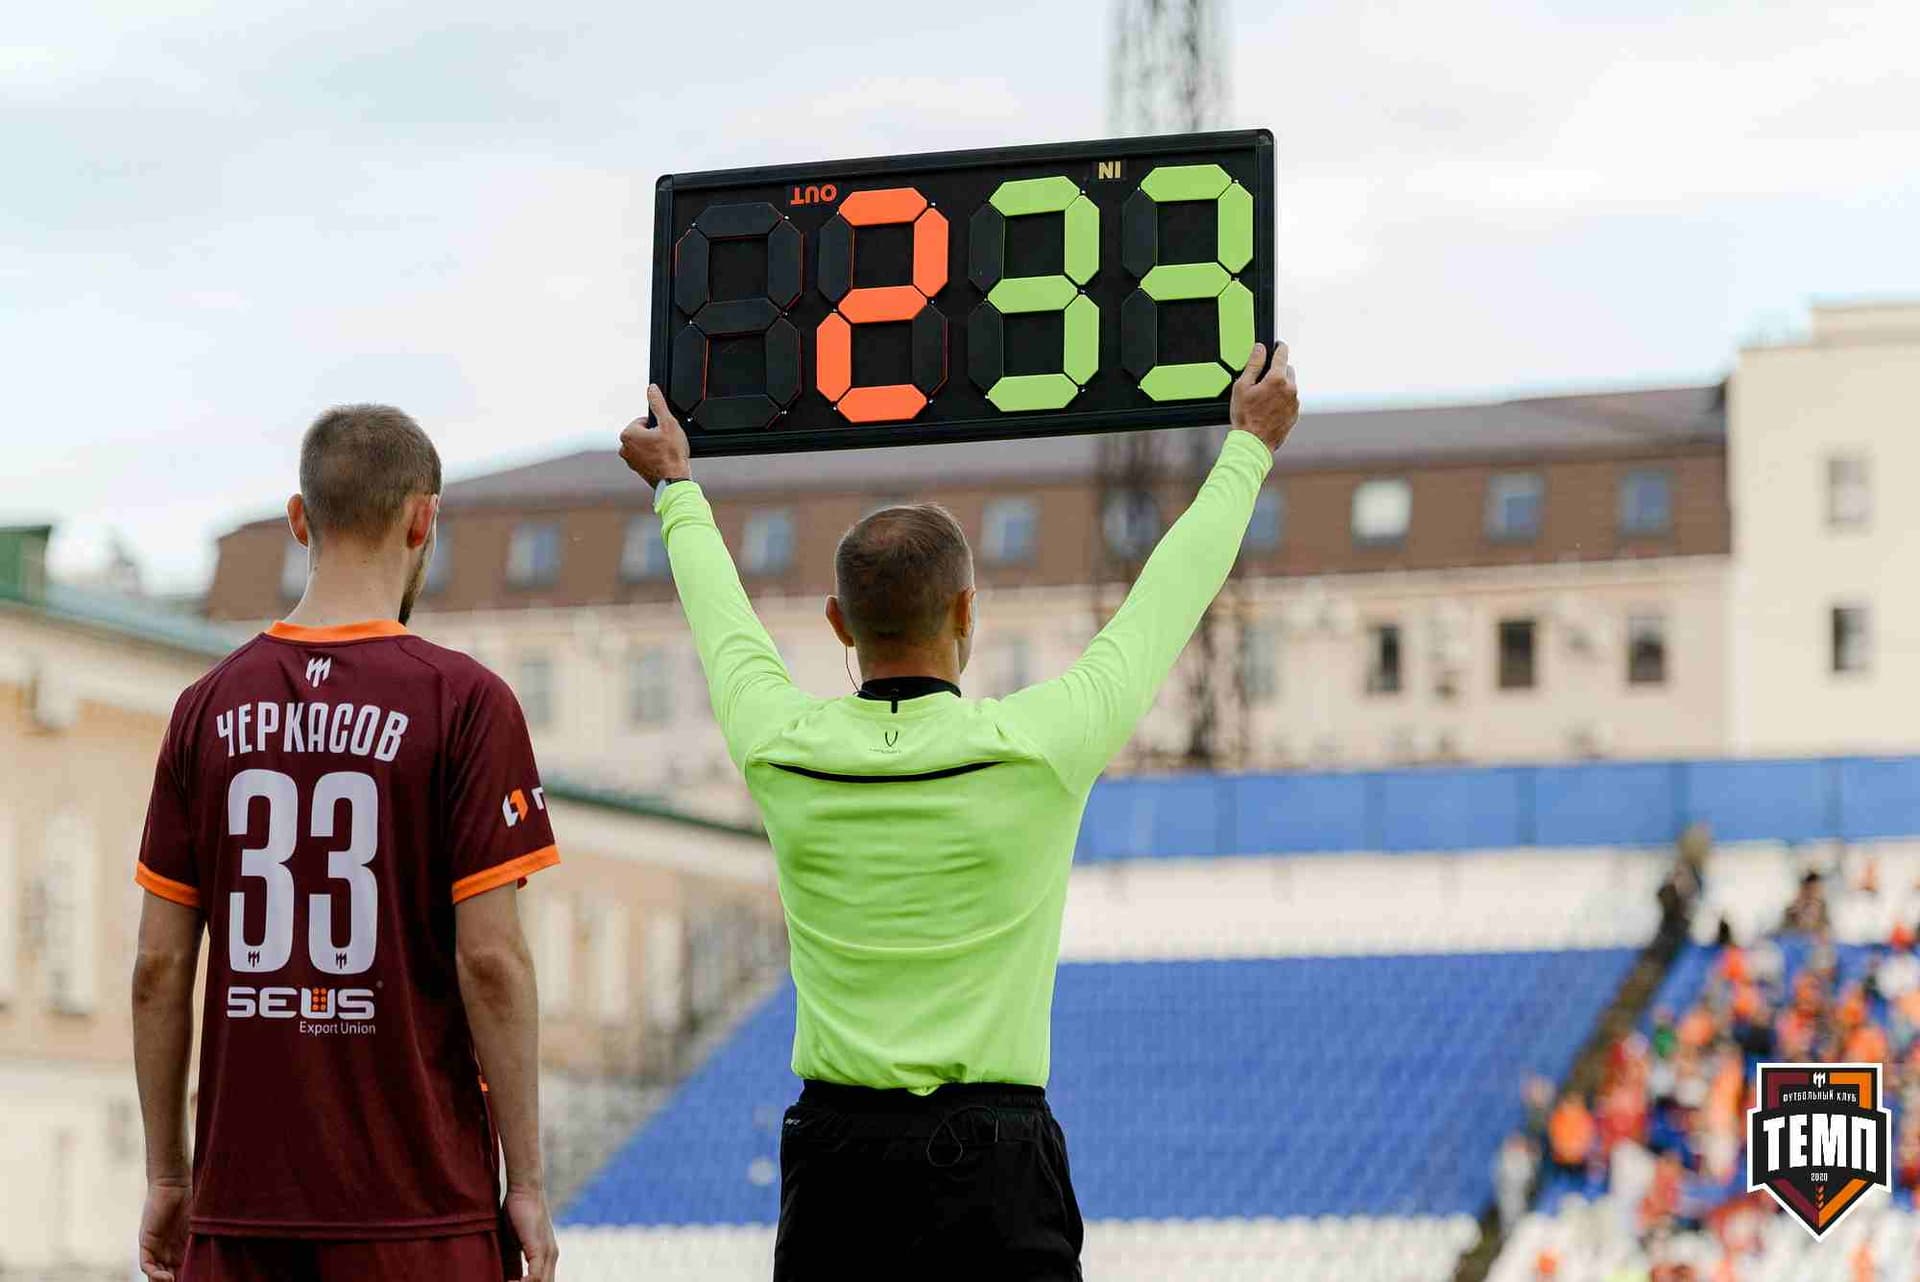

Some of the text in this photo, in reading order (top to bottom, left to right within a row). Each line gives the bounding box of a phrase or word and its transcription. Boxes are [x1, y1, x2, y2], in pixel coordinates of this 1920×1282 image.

[790, 183, 838, 205] OUT
[1098, 160, 1121, 180] IN
[816, 187, 949, 422] 2
[986, 164, 1255, 411] 33
[216, 701, 409, 763] ЧЕРКАСОВ
[227, 769, 379, 975] 33
[226, 986, 375, 1020] SEUS
[299, 1021, 376, 1036] Export Union
